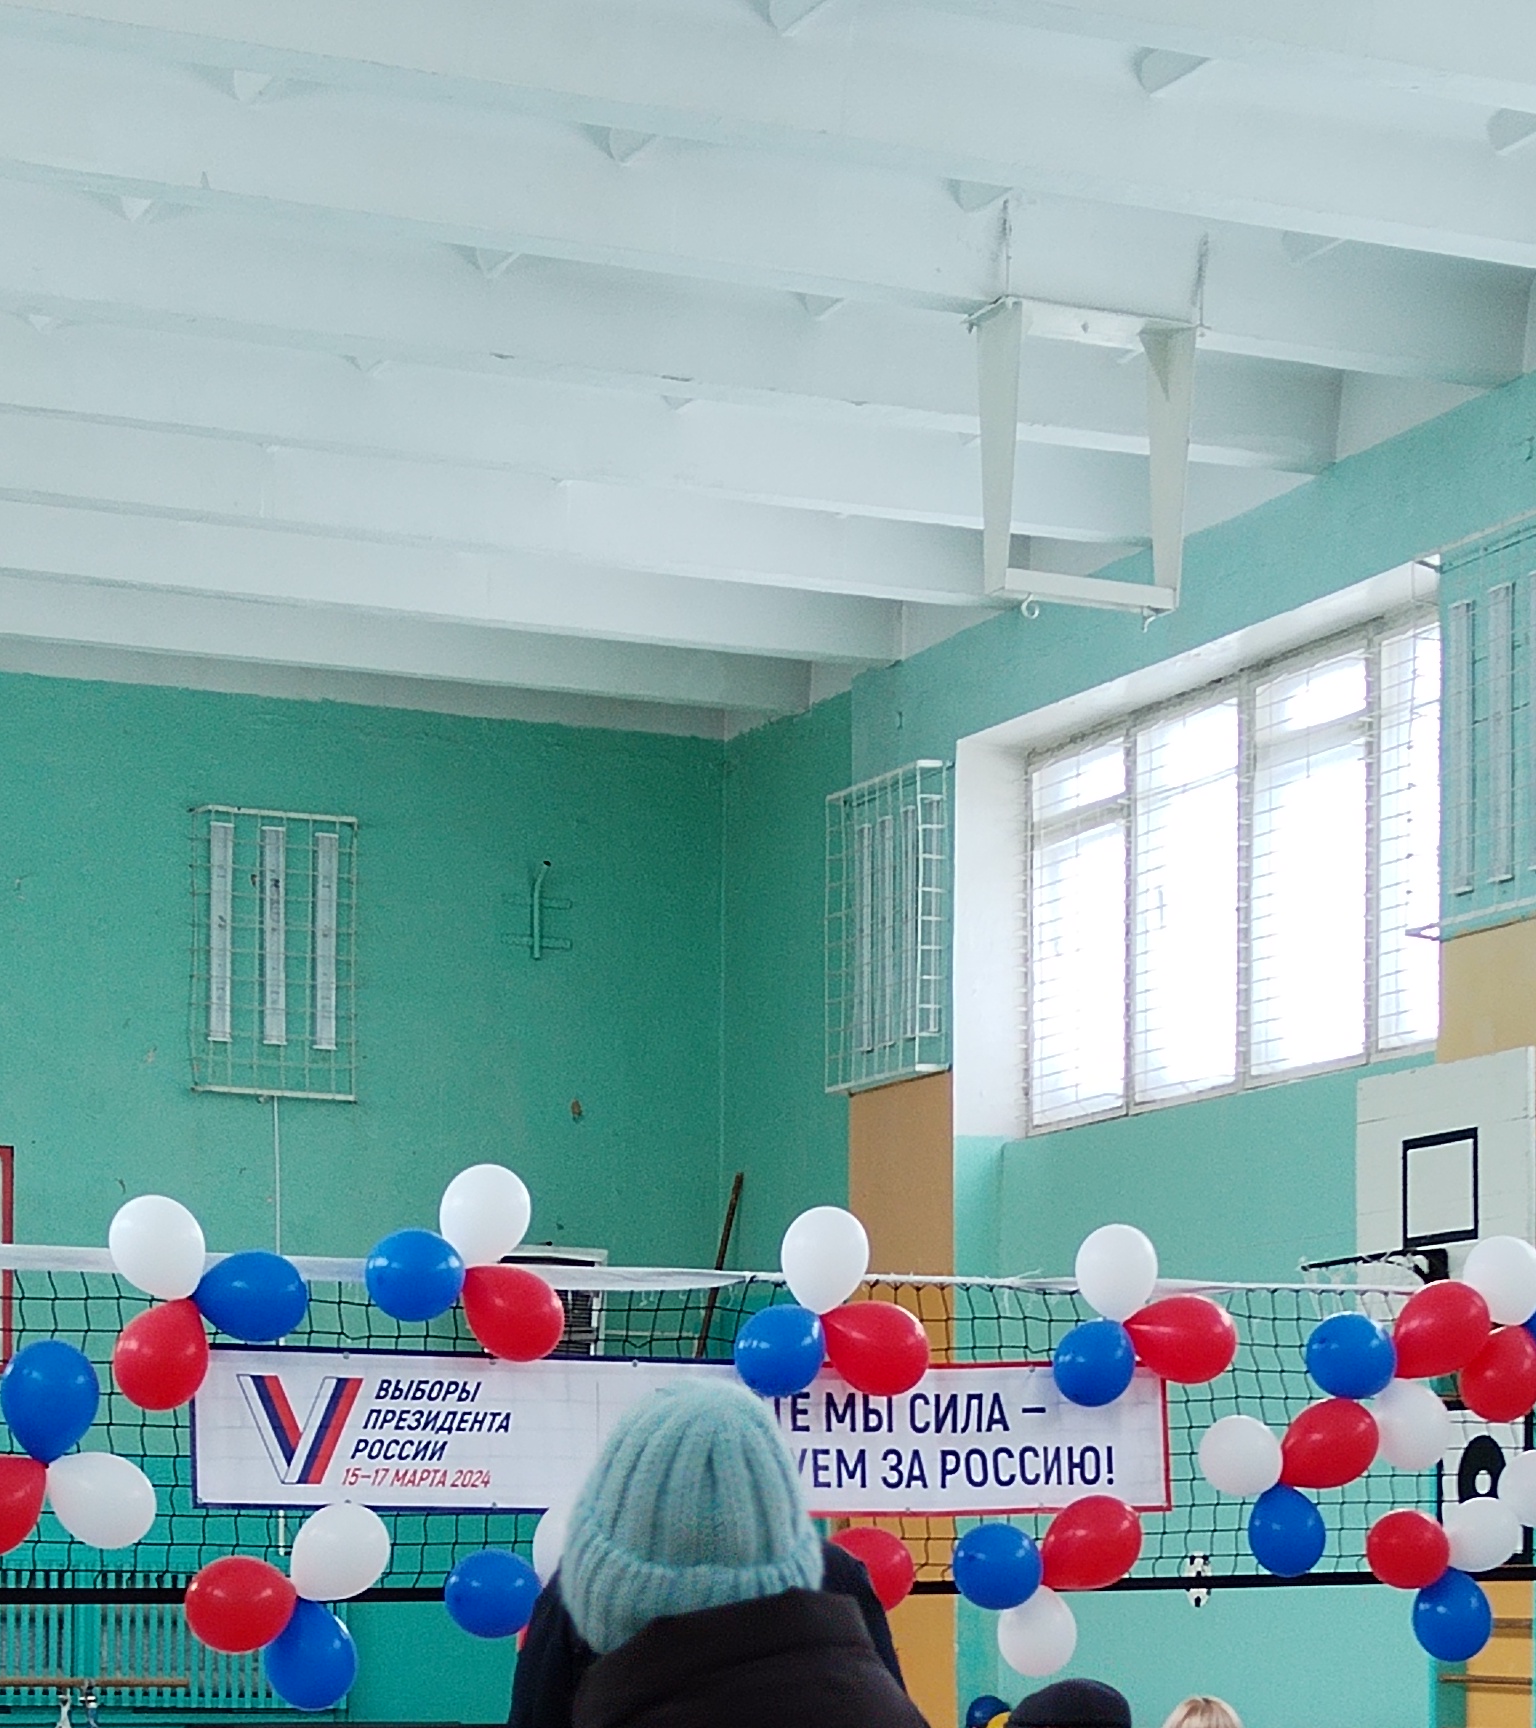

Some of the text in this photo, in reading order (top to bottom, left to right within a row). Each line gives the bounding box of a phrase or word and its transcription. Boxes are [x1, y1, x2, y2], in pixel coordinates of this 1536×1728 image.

[374, 1379, 482, 1403] ВЫБОРЫ
[362, 1409, 512, 1436] ПРЕЗИДЕНТА
[824, 1391, 894, 1434] МЫ
[908, 1392, 1010, 1434] СИЛА
[350, 1439, 448, 1462] РОССИИ
[390, 1468, 447, 1488] МАРТА
[450, 1469, 492, 1489] 2024
[880, 1448, 929, 1490] ЗА
[939, 1445, 1116, 1489] РОССИЮ!
